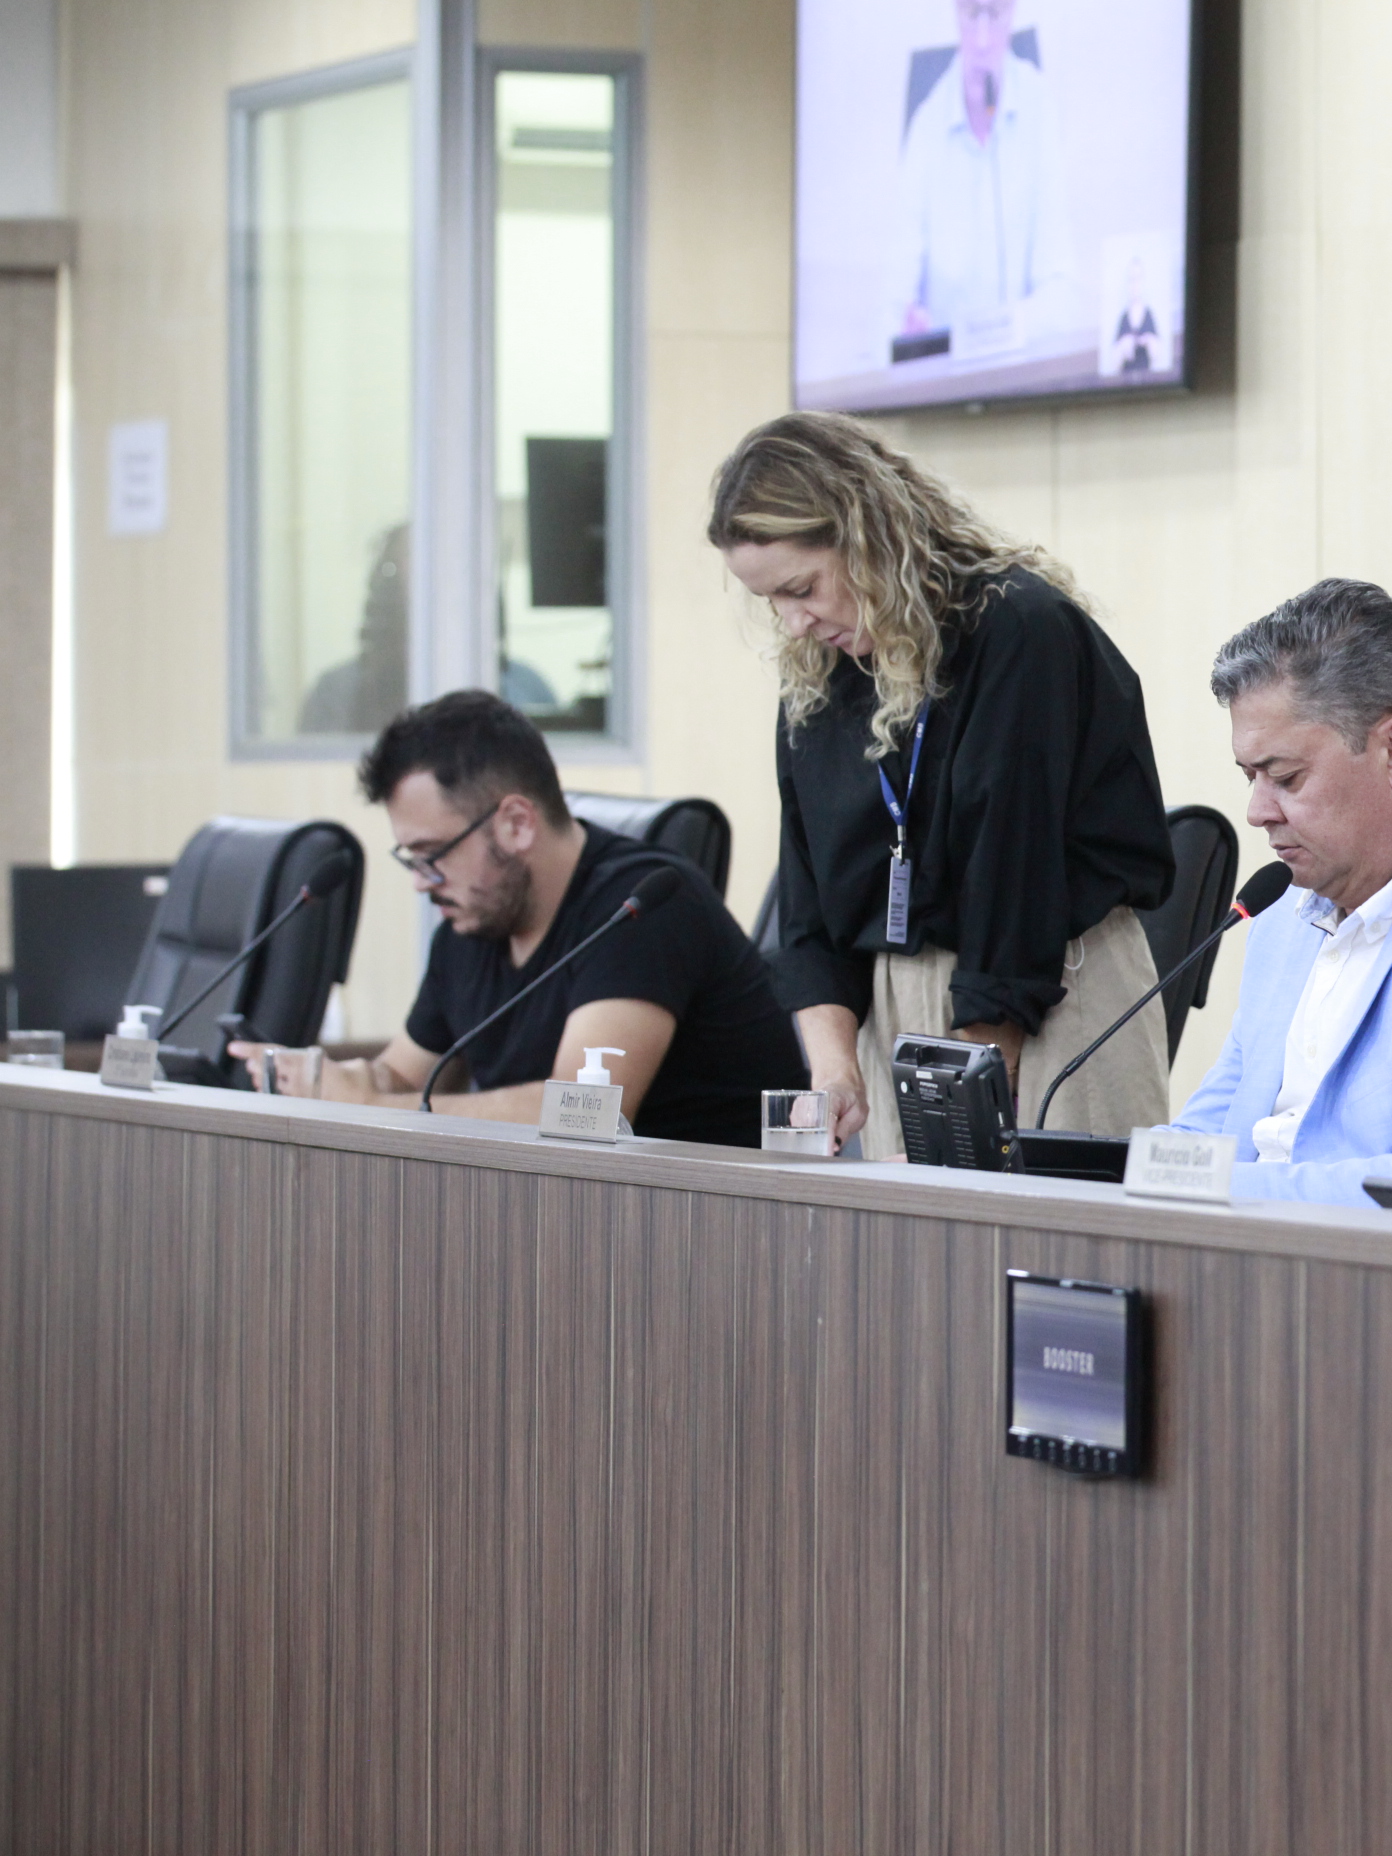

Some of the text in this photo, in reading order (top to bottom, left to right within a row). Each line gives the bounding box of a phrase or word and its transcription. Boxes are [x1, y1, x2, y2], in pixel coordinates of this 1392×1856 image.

[560, 1091, 602, 1110] Almir Vieira
[559, 1113, 597, 1130] PRESIDENTE
[1043, 1346, 1094, 1375] BOOSTER
